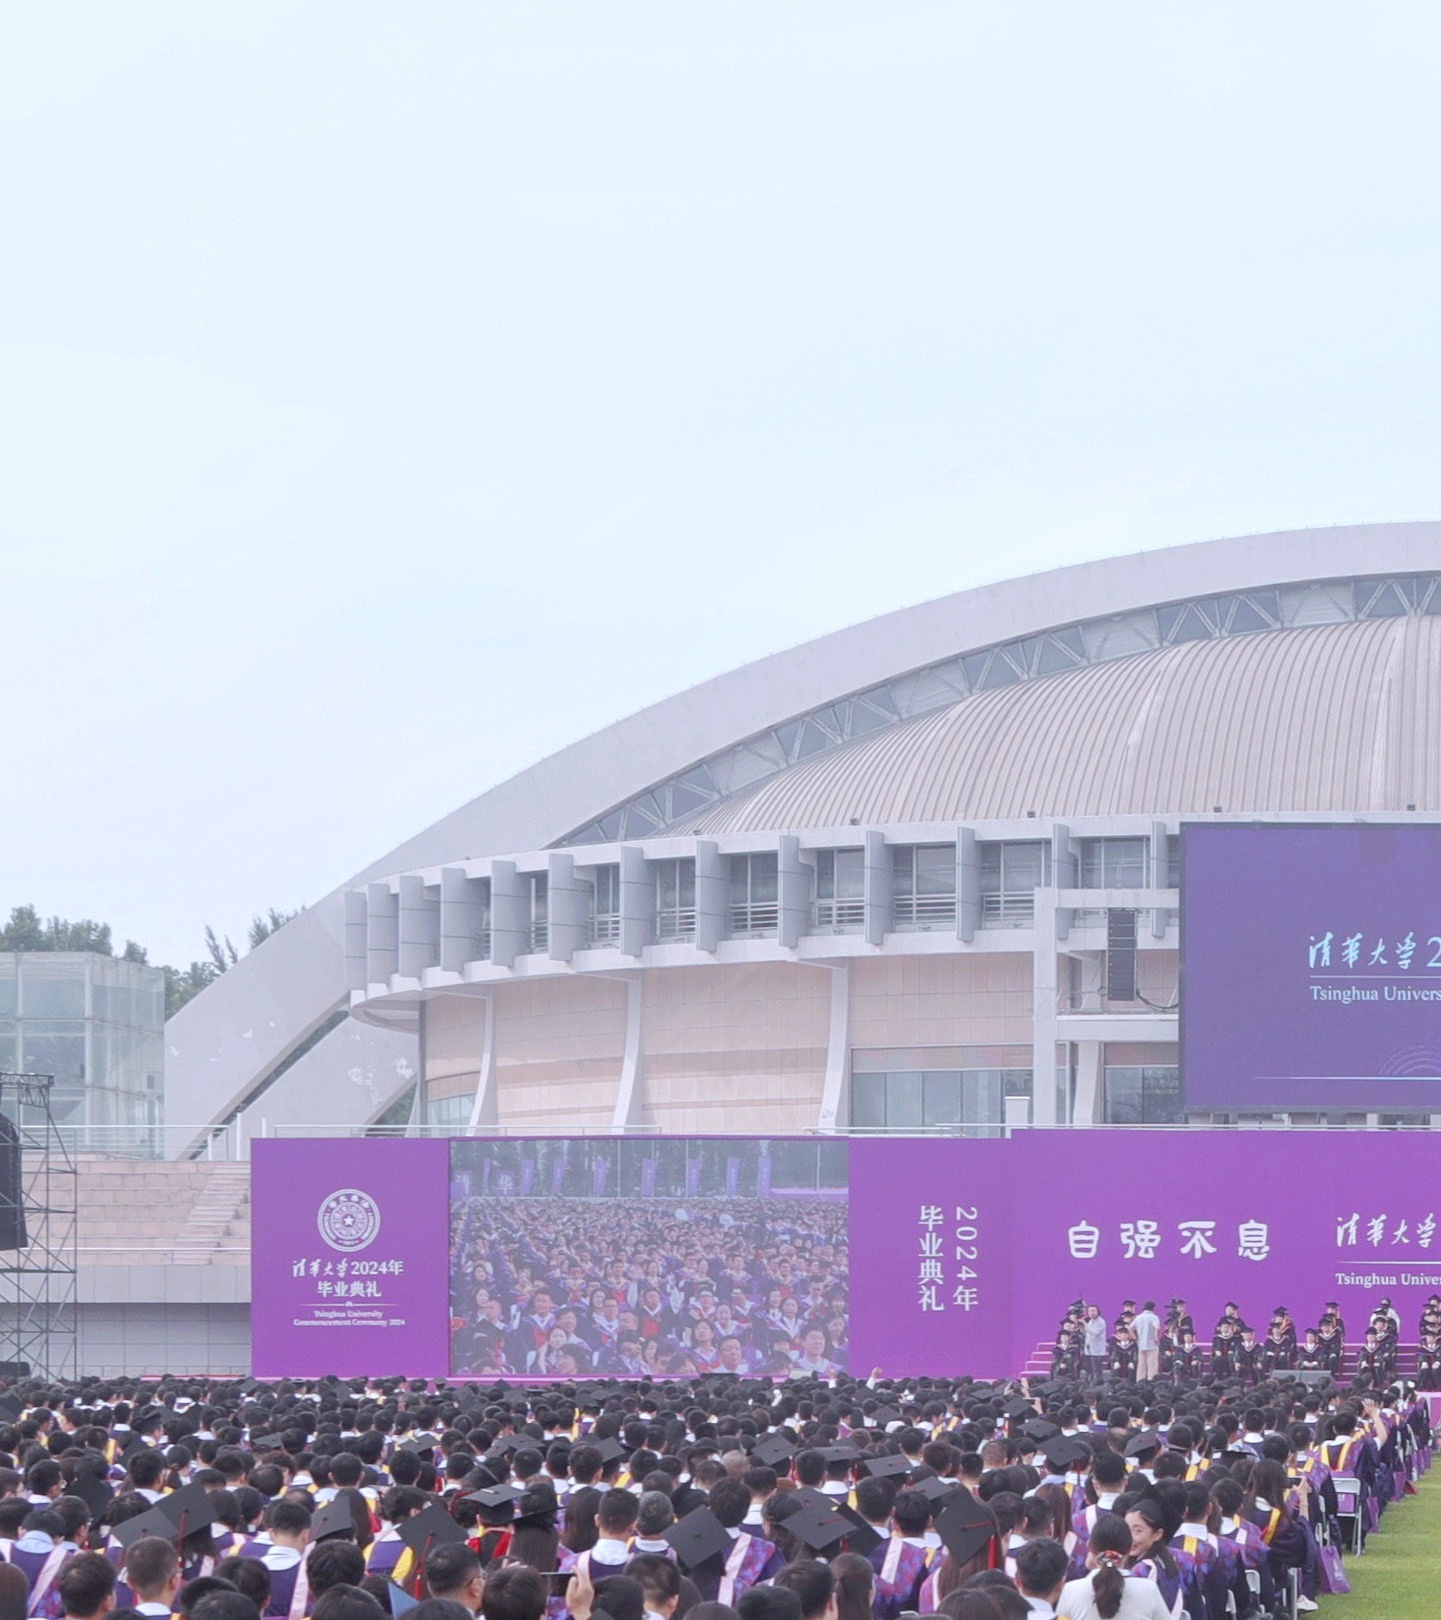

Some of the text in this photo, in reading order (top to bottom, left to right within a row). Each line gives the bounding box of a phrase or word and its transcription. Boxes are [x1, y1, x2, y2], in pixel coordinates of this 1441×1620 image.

[1310, 986, 1379, 1004] Tsinghua
[1068, 1219, 1271, 1261] 自强不息
[918, 1205, 945, 1312] 毕业典礼
[952, 1206, 979, 1312] 2024年
[317, 1280, 382, 1298] 毕业典礼
[1335, 1273, 1397, 1288] Tsinghua
